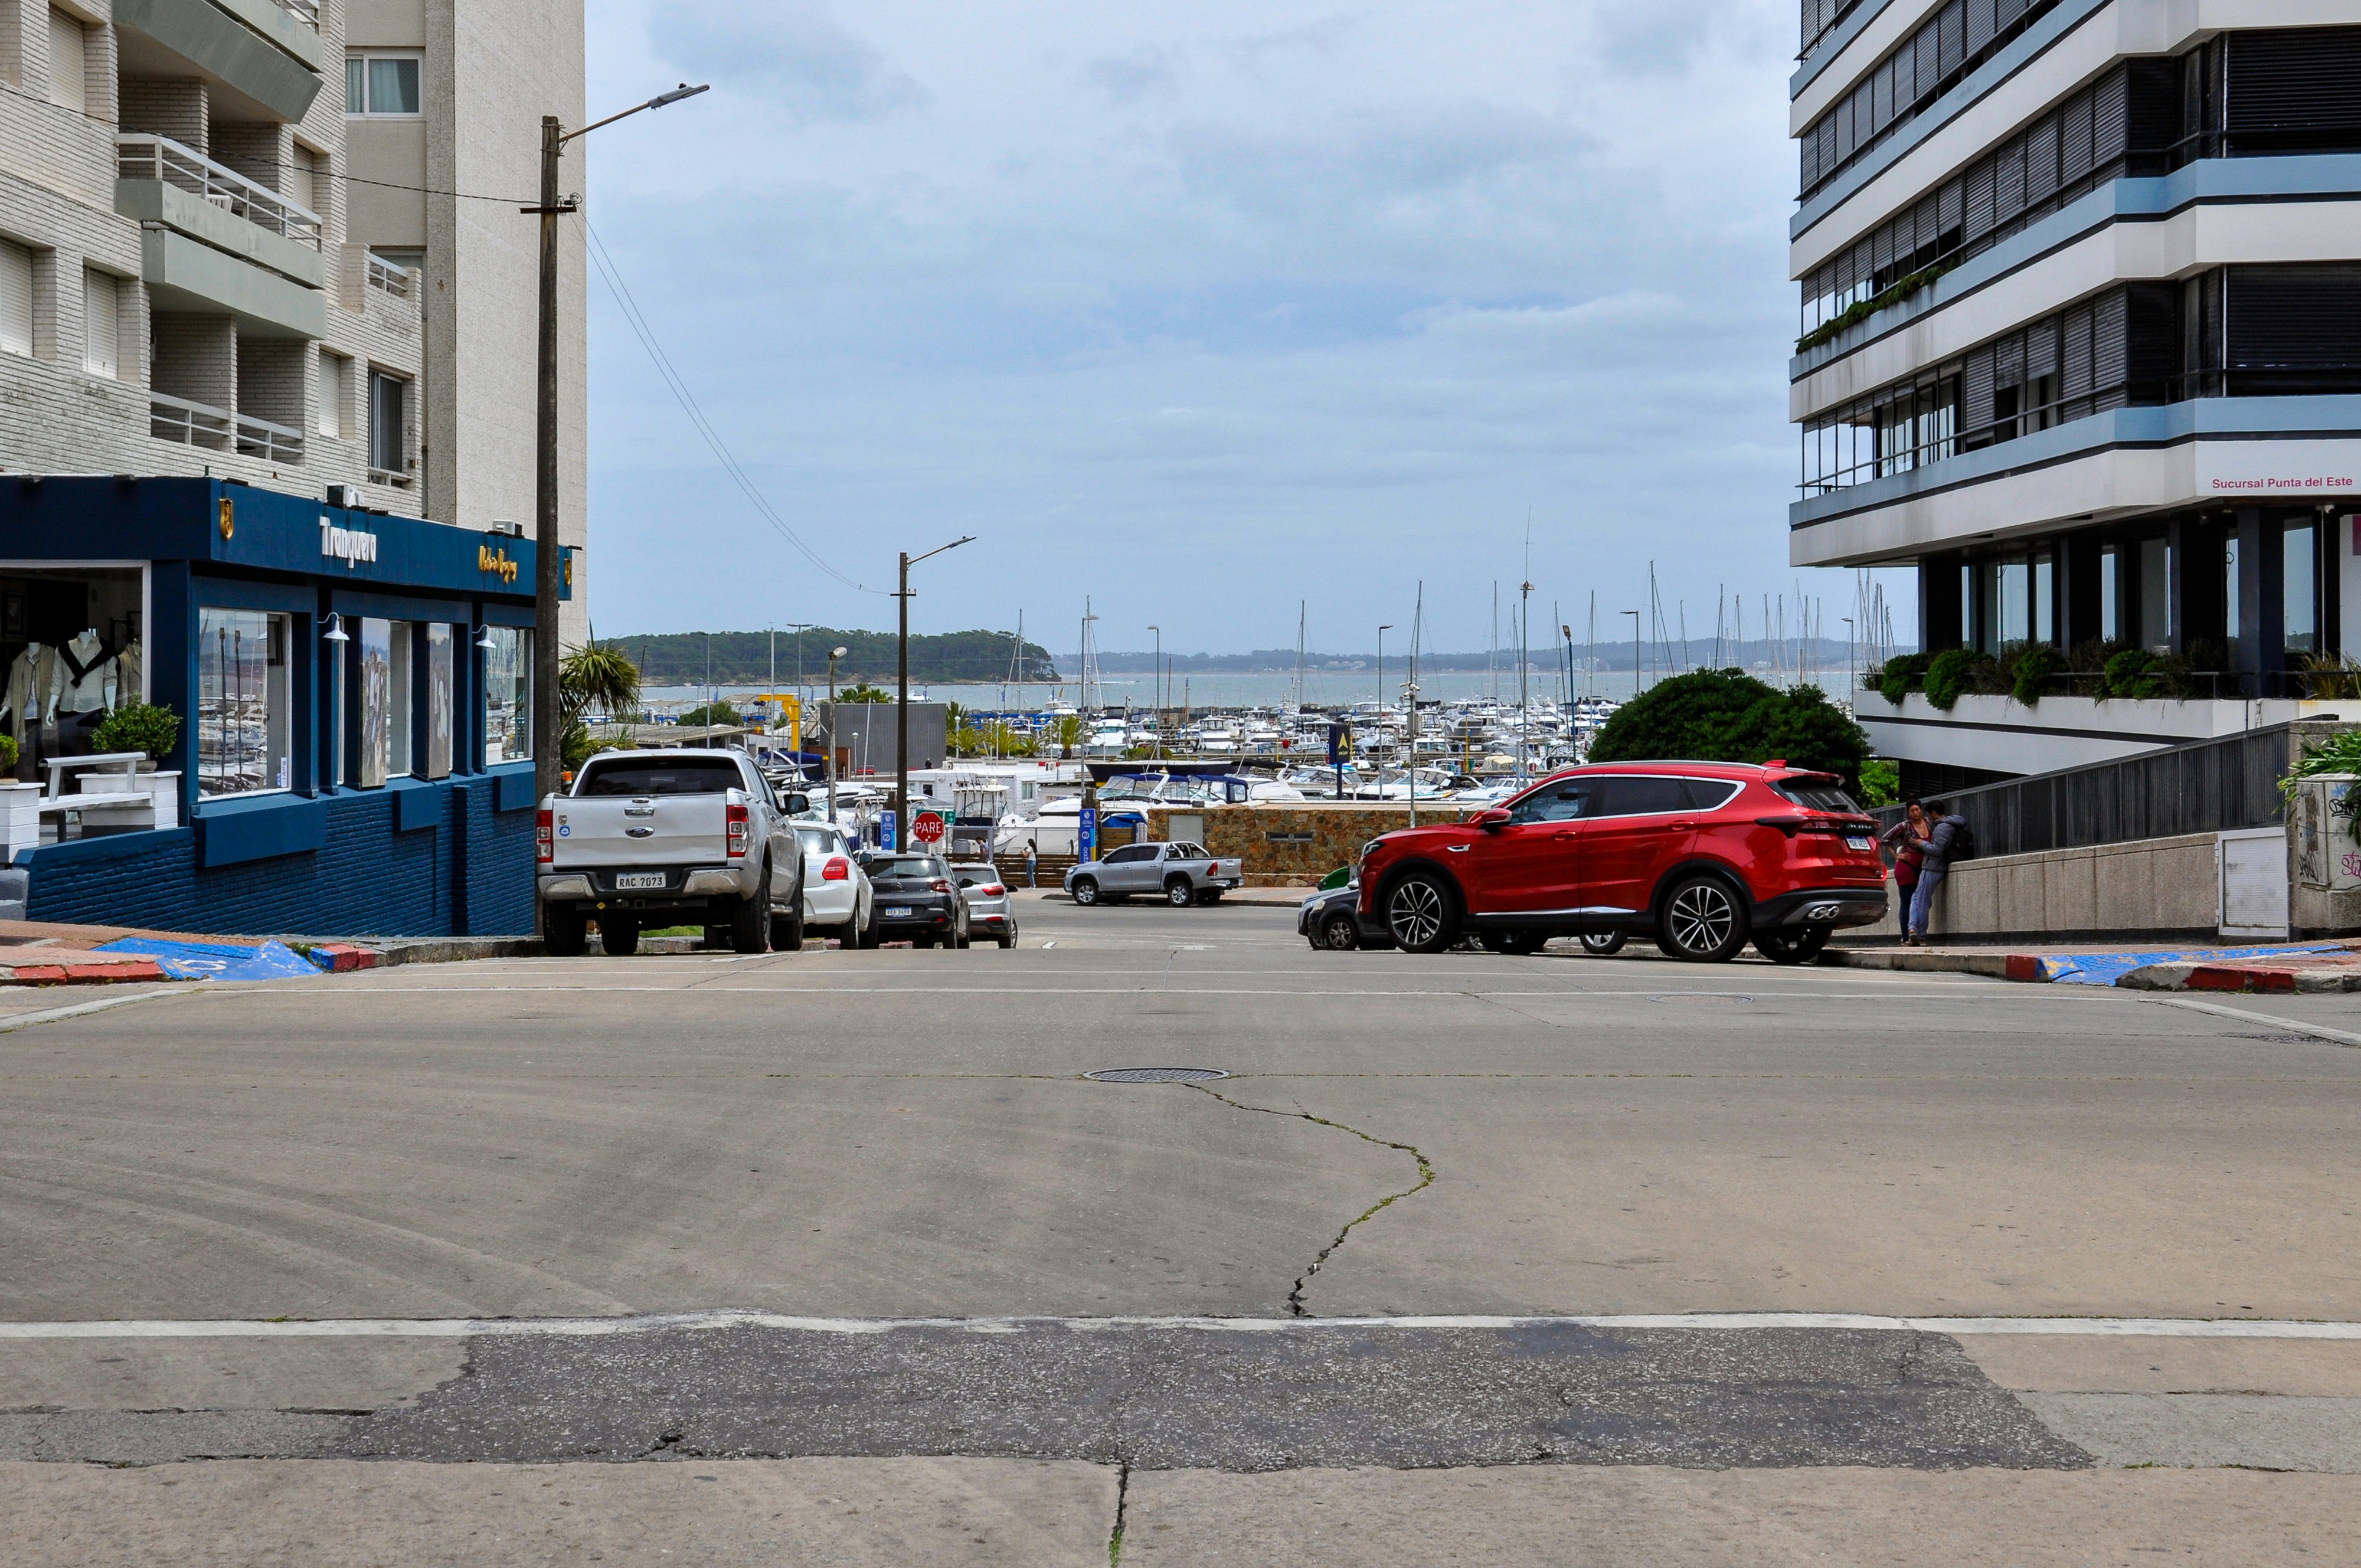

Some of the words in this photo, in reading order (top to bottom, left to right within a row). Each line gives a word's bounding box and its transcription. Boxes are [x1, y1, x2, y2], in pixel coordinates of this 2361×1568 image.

[2212, 479, 2264, 489] Sucursal
[2268, 479, 2301, 488] Punta
[2305, 477, 2323, 487] del
[2327, 477, 2353, 486] Este
[319, 516, 376, 568] Tranquera
[915, 821, 941, 833] PARE
[619, 878, 636, 887] RAC
[640, 877, 663, 886] 7073
